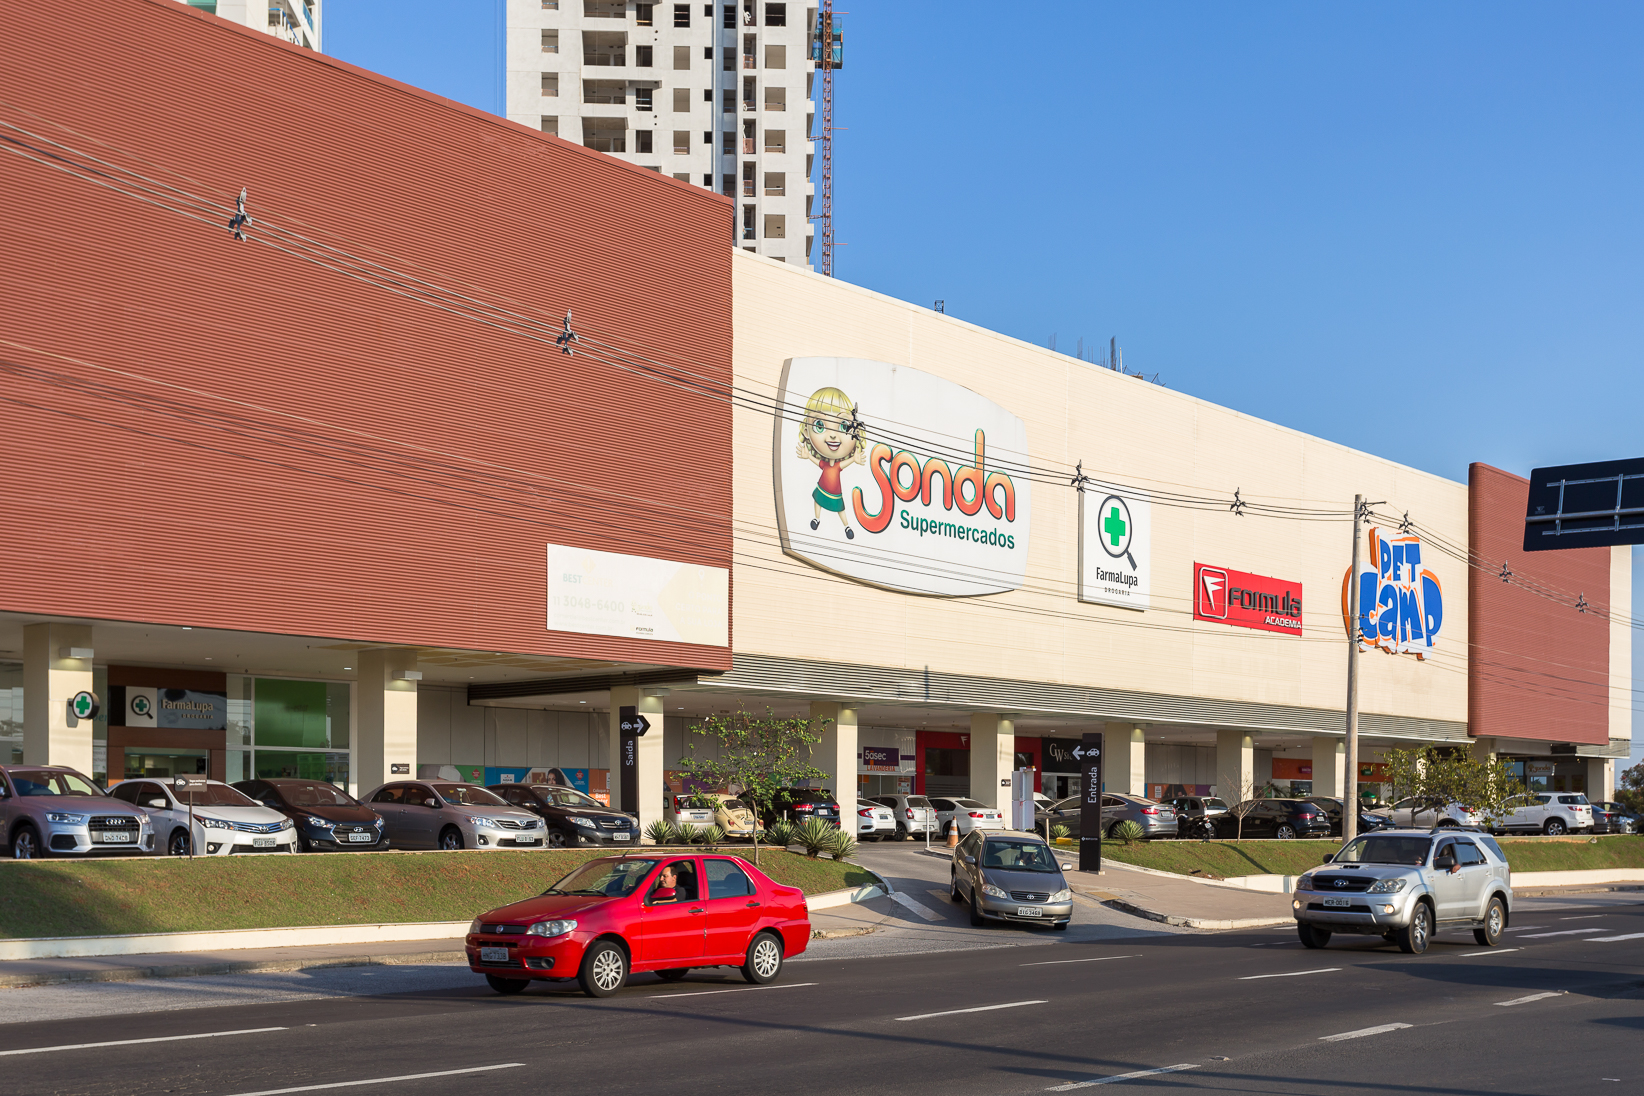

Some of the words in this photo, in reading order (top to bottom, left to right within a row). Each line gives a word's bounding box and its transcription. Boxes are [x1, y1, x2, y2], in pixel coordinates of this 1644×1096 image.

[900, 509, 1015, 550] Supermercados
[1379, 538, 1421, 583] PET
[1096, 566, 1138, 588] FarmaLupa
[1104, 586, 1131, 597] DROGARIA
[563, 595, 625, 613] 3048-6400
[1264, 615, 1302, 629] ACADEMIA
[161, 699, 214, 713] FarmaLupa
[625, 740, 634, 766] Saída
[866, 764, 896, 772] LAVANDERIA
[1087, 766, 1098, 804] Entrada
